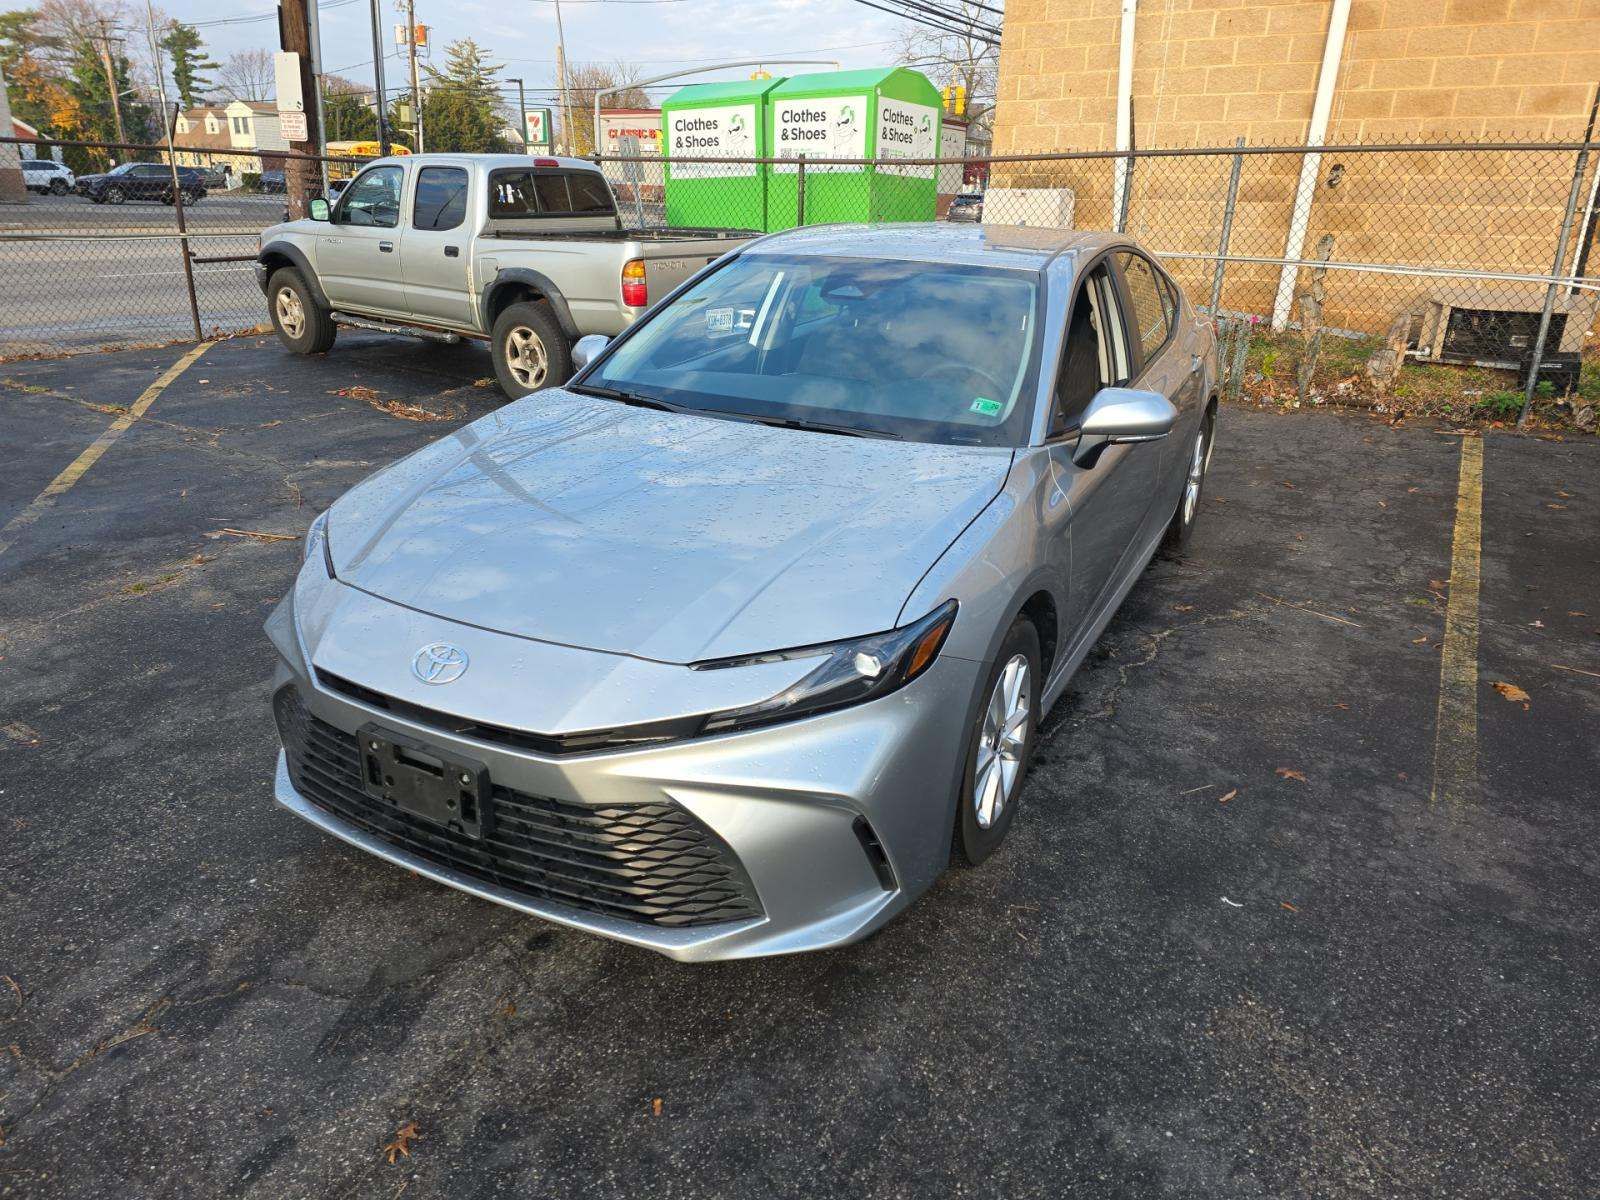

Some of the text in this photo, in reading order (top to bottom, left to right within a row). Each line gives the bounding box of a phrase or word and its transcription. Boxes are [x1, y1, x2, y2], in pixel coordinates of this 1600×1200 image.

[781, 109, 827, 123] Clothes
[882, 108, 914, 127] Clothes
[675, 117, 719, 132] Clothes
[675, 134, 720, 149] & Shoes
[781, 127, 827, 141] & Shoes
[881, 126, 913, 144] & Shoes
[653, 260, 688, 271] TOYOTA
